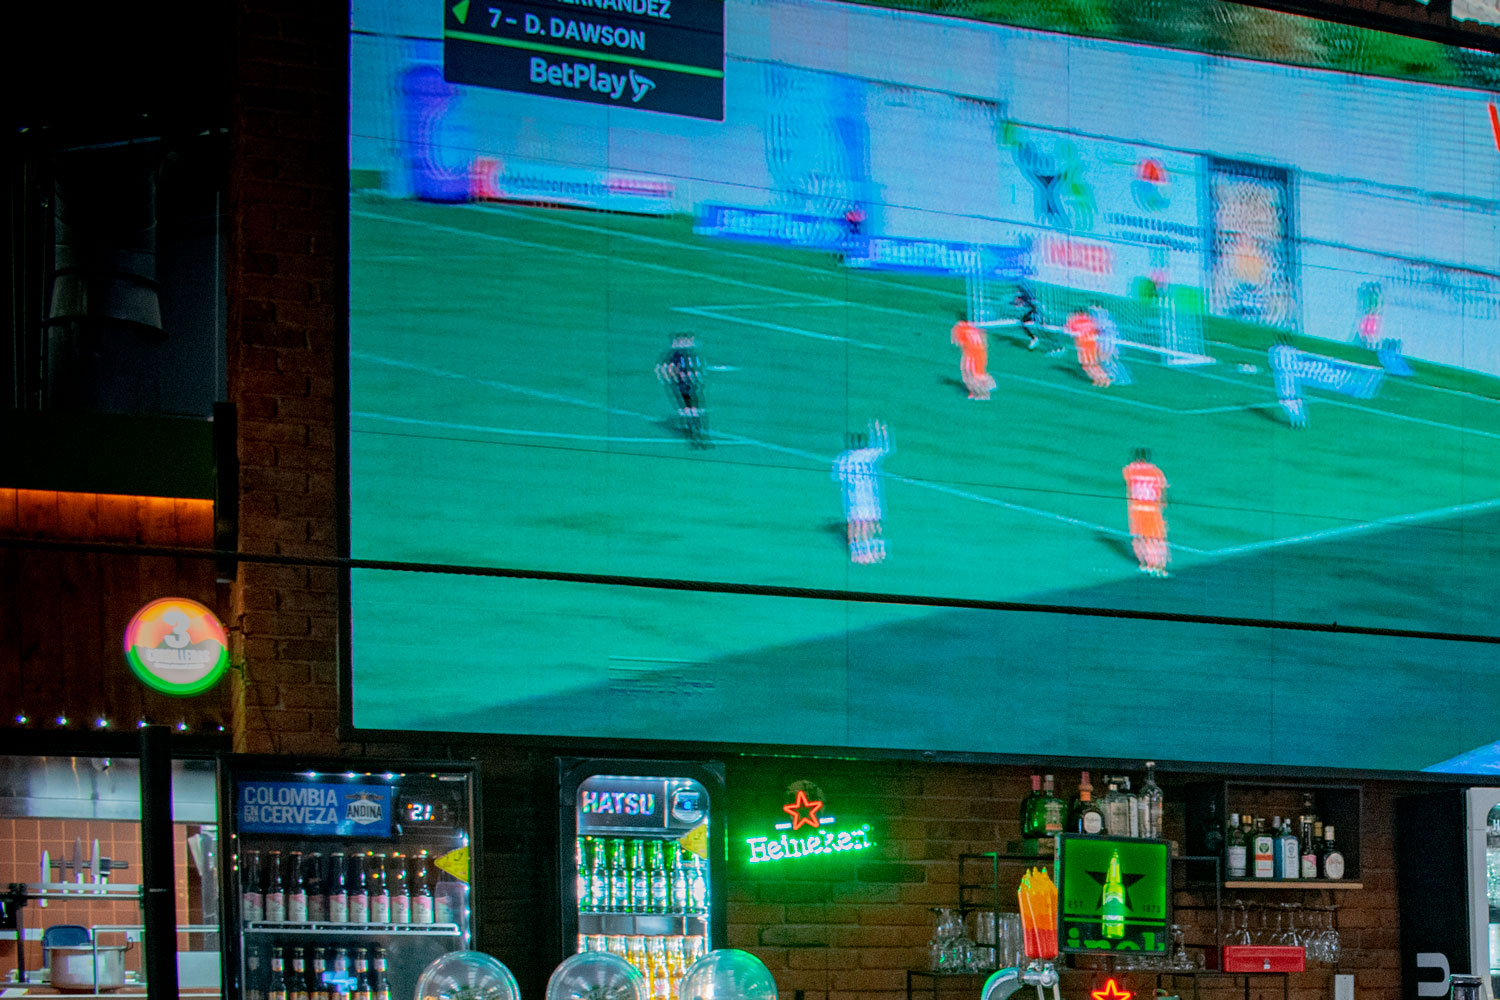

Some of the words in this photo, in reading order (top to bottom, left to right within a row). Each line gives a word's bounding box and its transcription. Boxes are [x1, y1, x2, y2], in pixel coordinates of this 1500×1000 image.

[558, 0, 671, 19] ANDEZ
[549, 17, 646, 51] DAWSON
[530, 56, 627, 99] BetPlay
[244, 786, 338, 807] COLOMBIA
[581, 791, 655, 816] HATSU
[260, 805, 338, 825] CERVEZA
[346, 804, 382, 818] ANDINA
